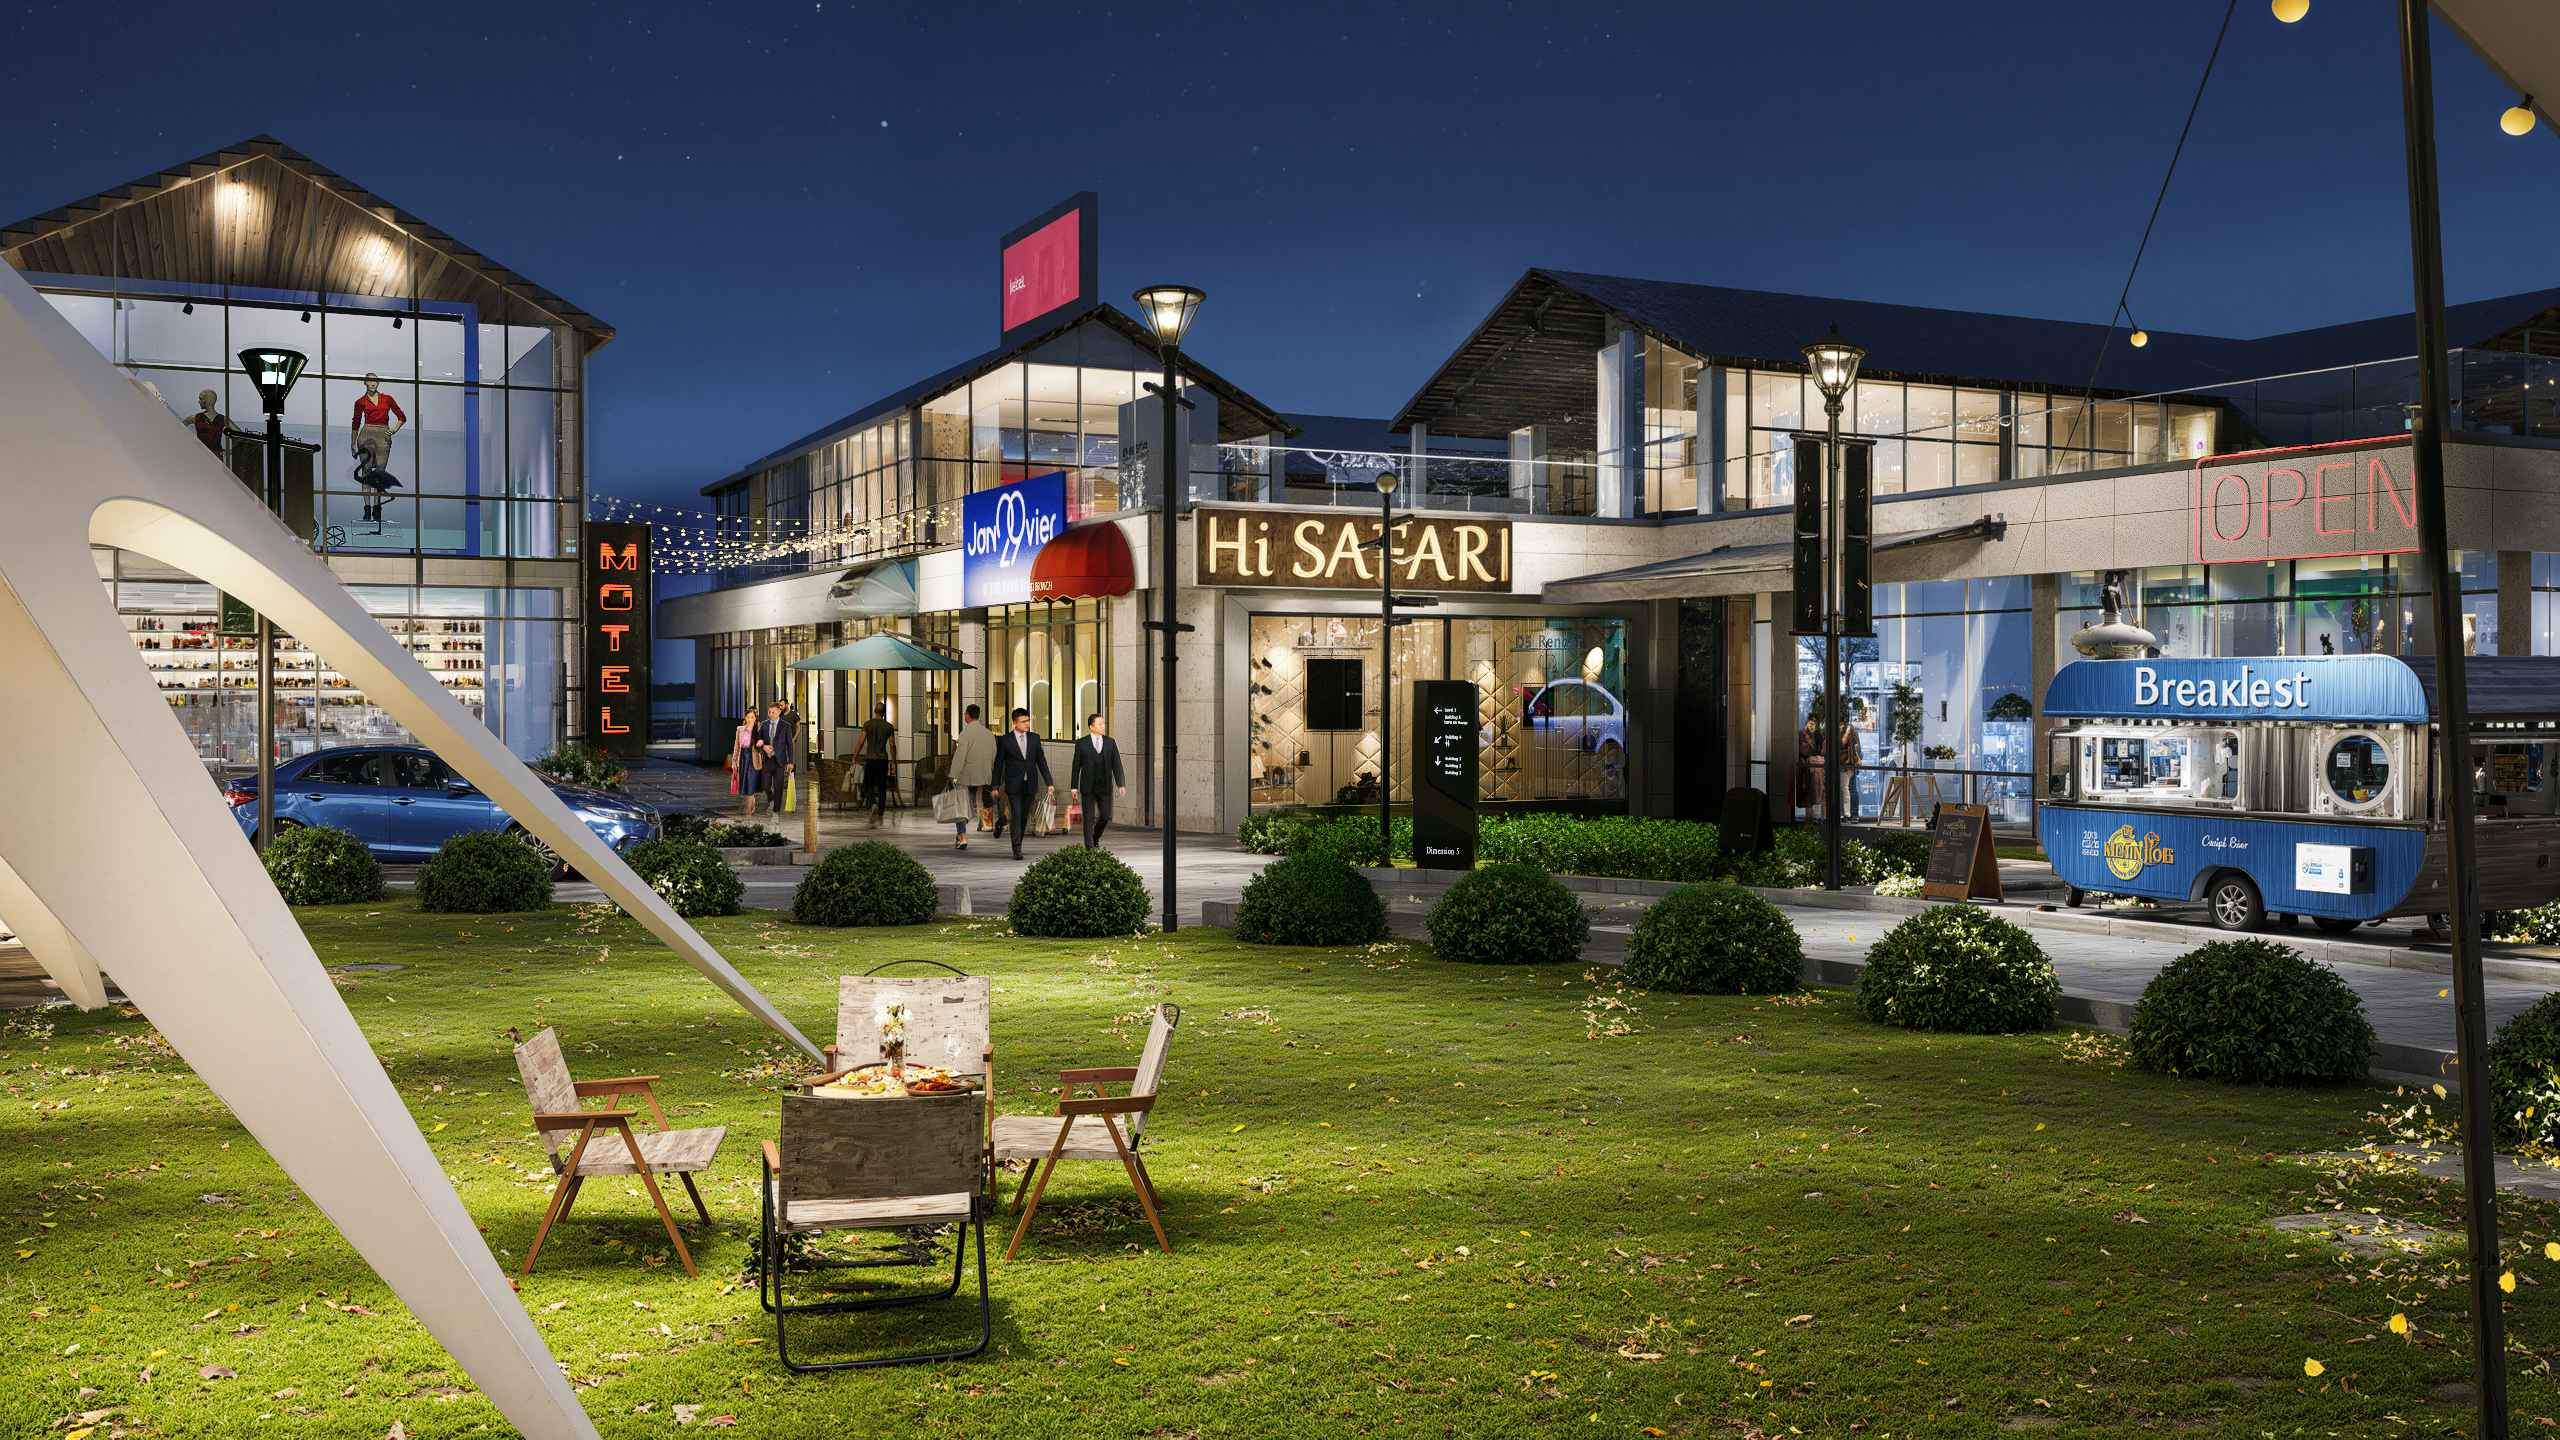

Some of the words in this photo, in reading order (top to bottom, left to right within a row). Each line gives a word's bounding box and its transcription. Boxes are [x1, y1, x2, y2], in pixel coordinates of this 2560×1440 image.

[2209, 457, 2416, 542] OPEN
[1208, 515, 1274, 578] Hi
[1292, 519, 1510, 583] SAFARI
[600, 542, 638, 734] MOTEL
[1426, 846, 1455, 855] Dimension
[1455, 847, 1460, 856] 5
